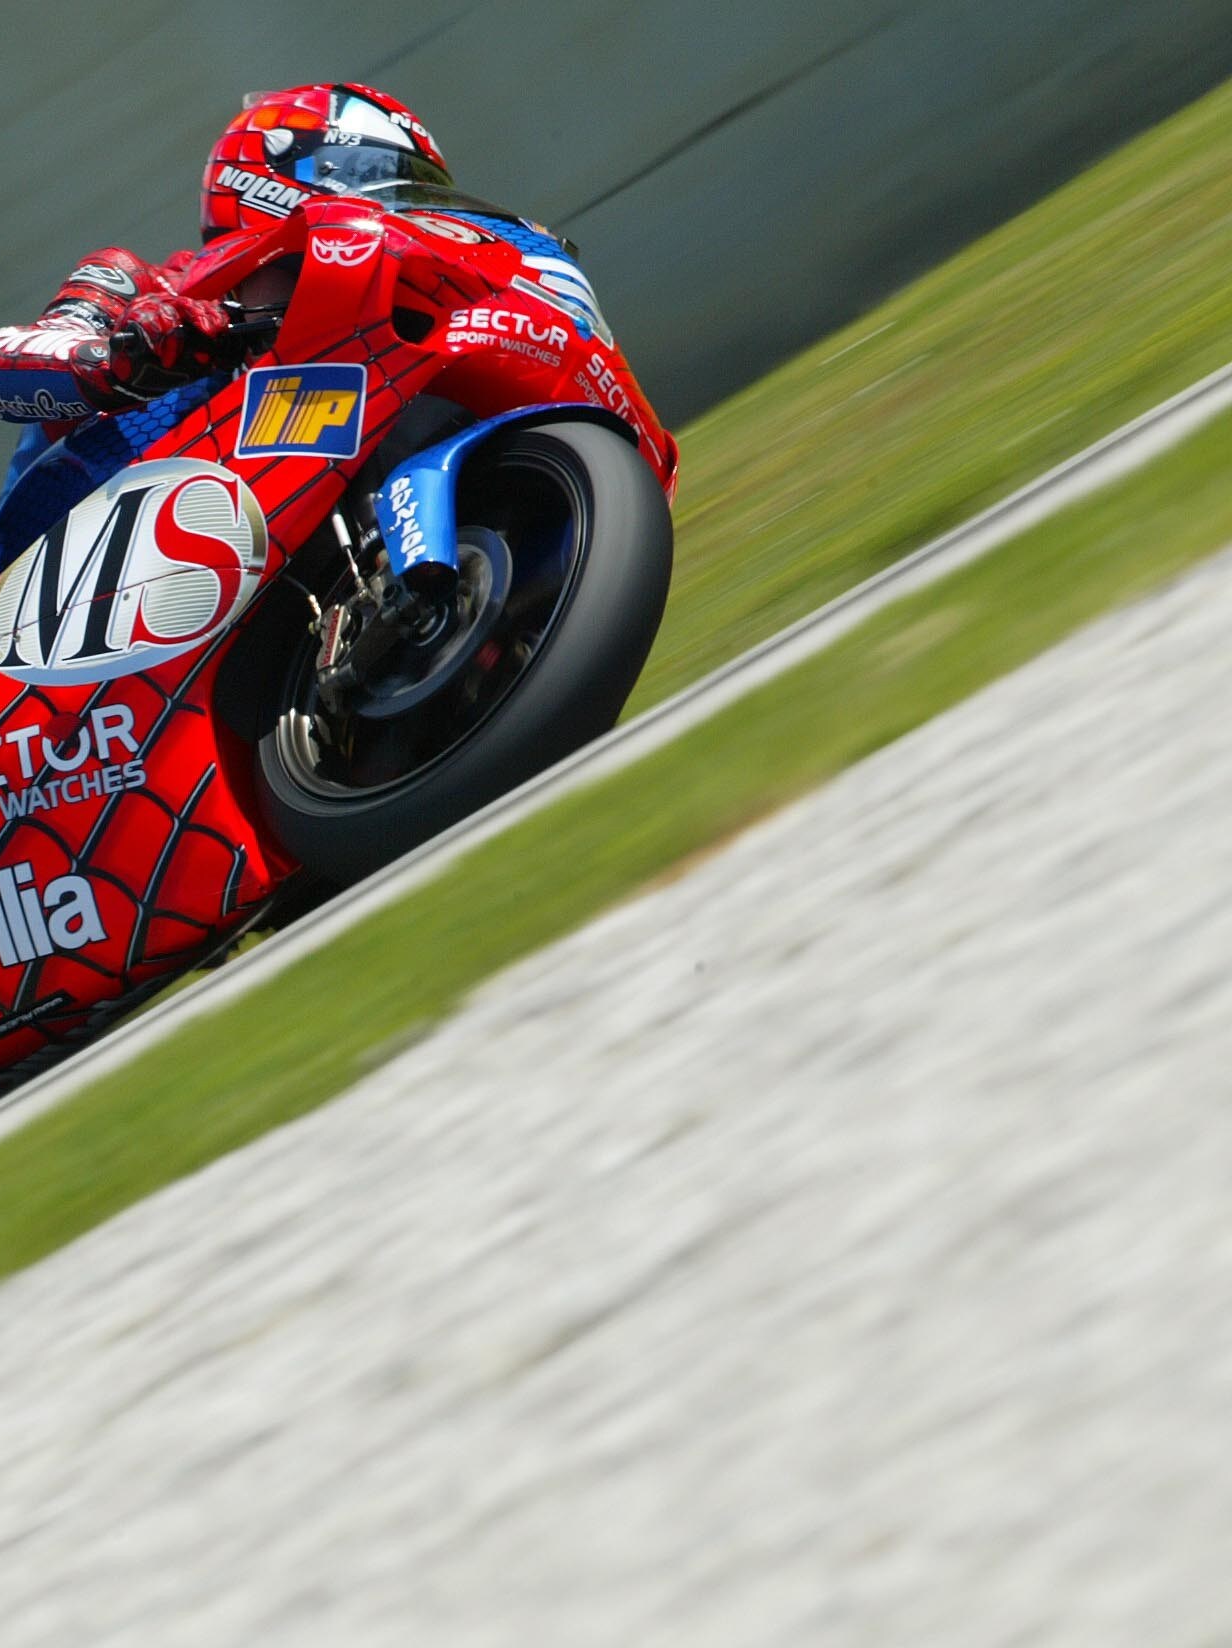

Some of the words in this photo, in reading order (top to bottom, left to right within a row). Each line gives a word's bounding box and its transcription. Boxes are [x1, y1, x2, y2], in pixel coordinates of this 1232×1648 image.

[323, 129, 363, 146] N93
[216, 165, 311, 218] NOLAN
[445, 331, 497, 345] SPORT
[498, 335, 562, 368] WATCHES
[448, 308, 569, 351] SECTOR
[574, 371, 603, 406] SPOR
[586, 352, 641, 437] SECT
[388, 477, 427, 568] DUNLOP
